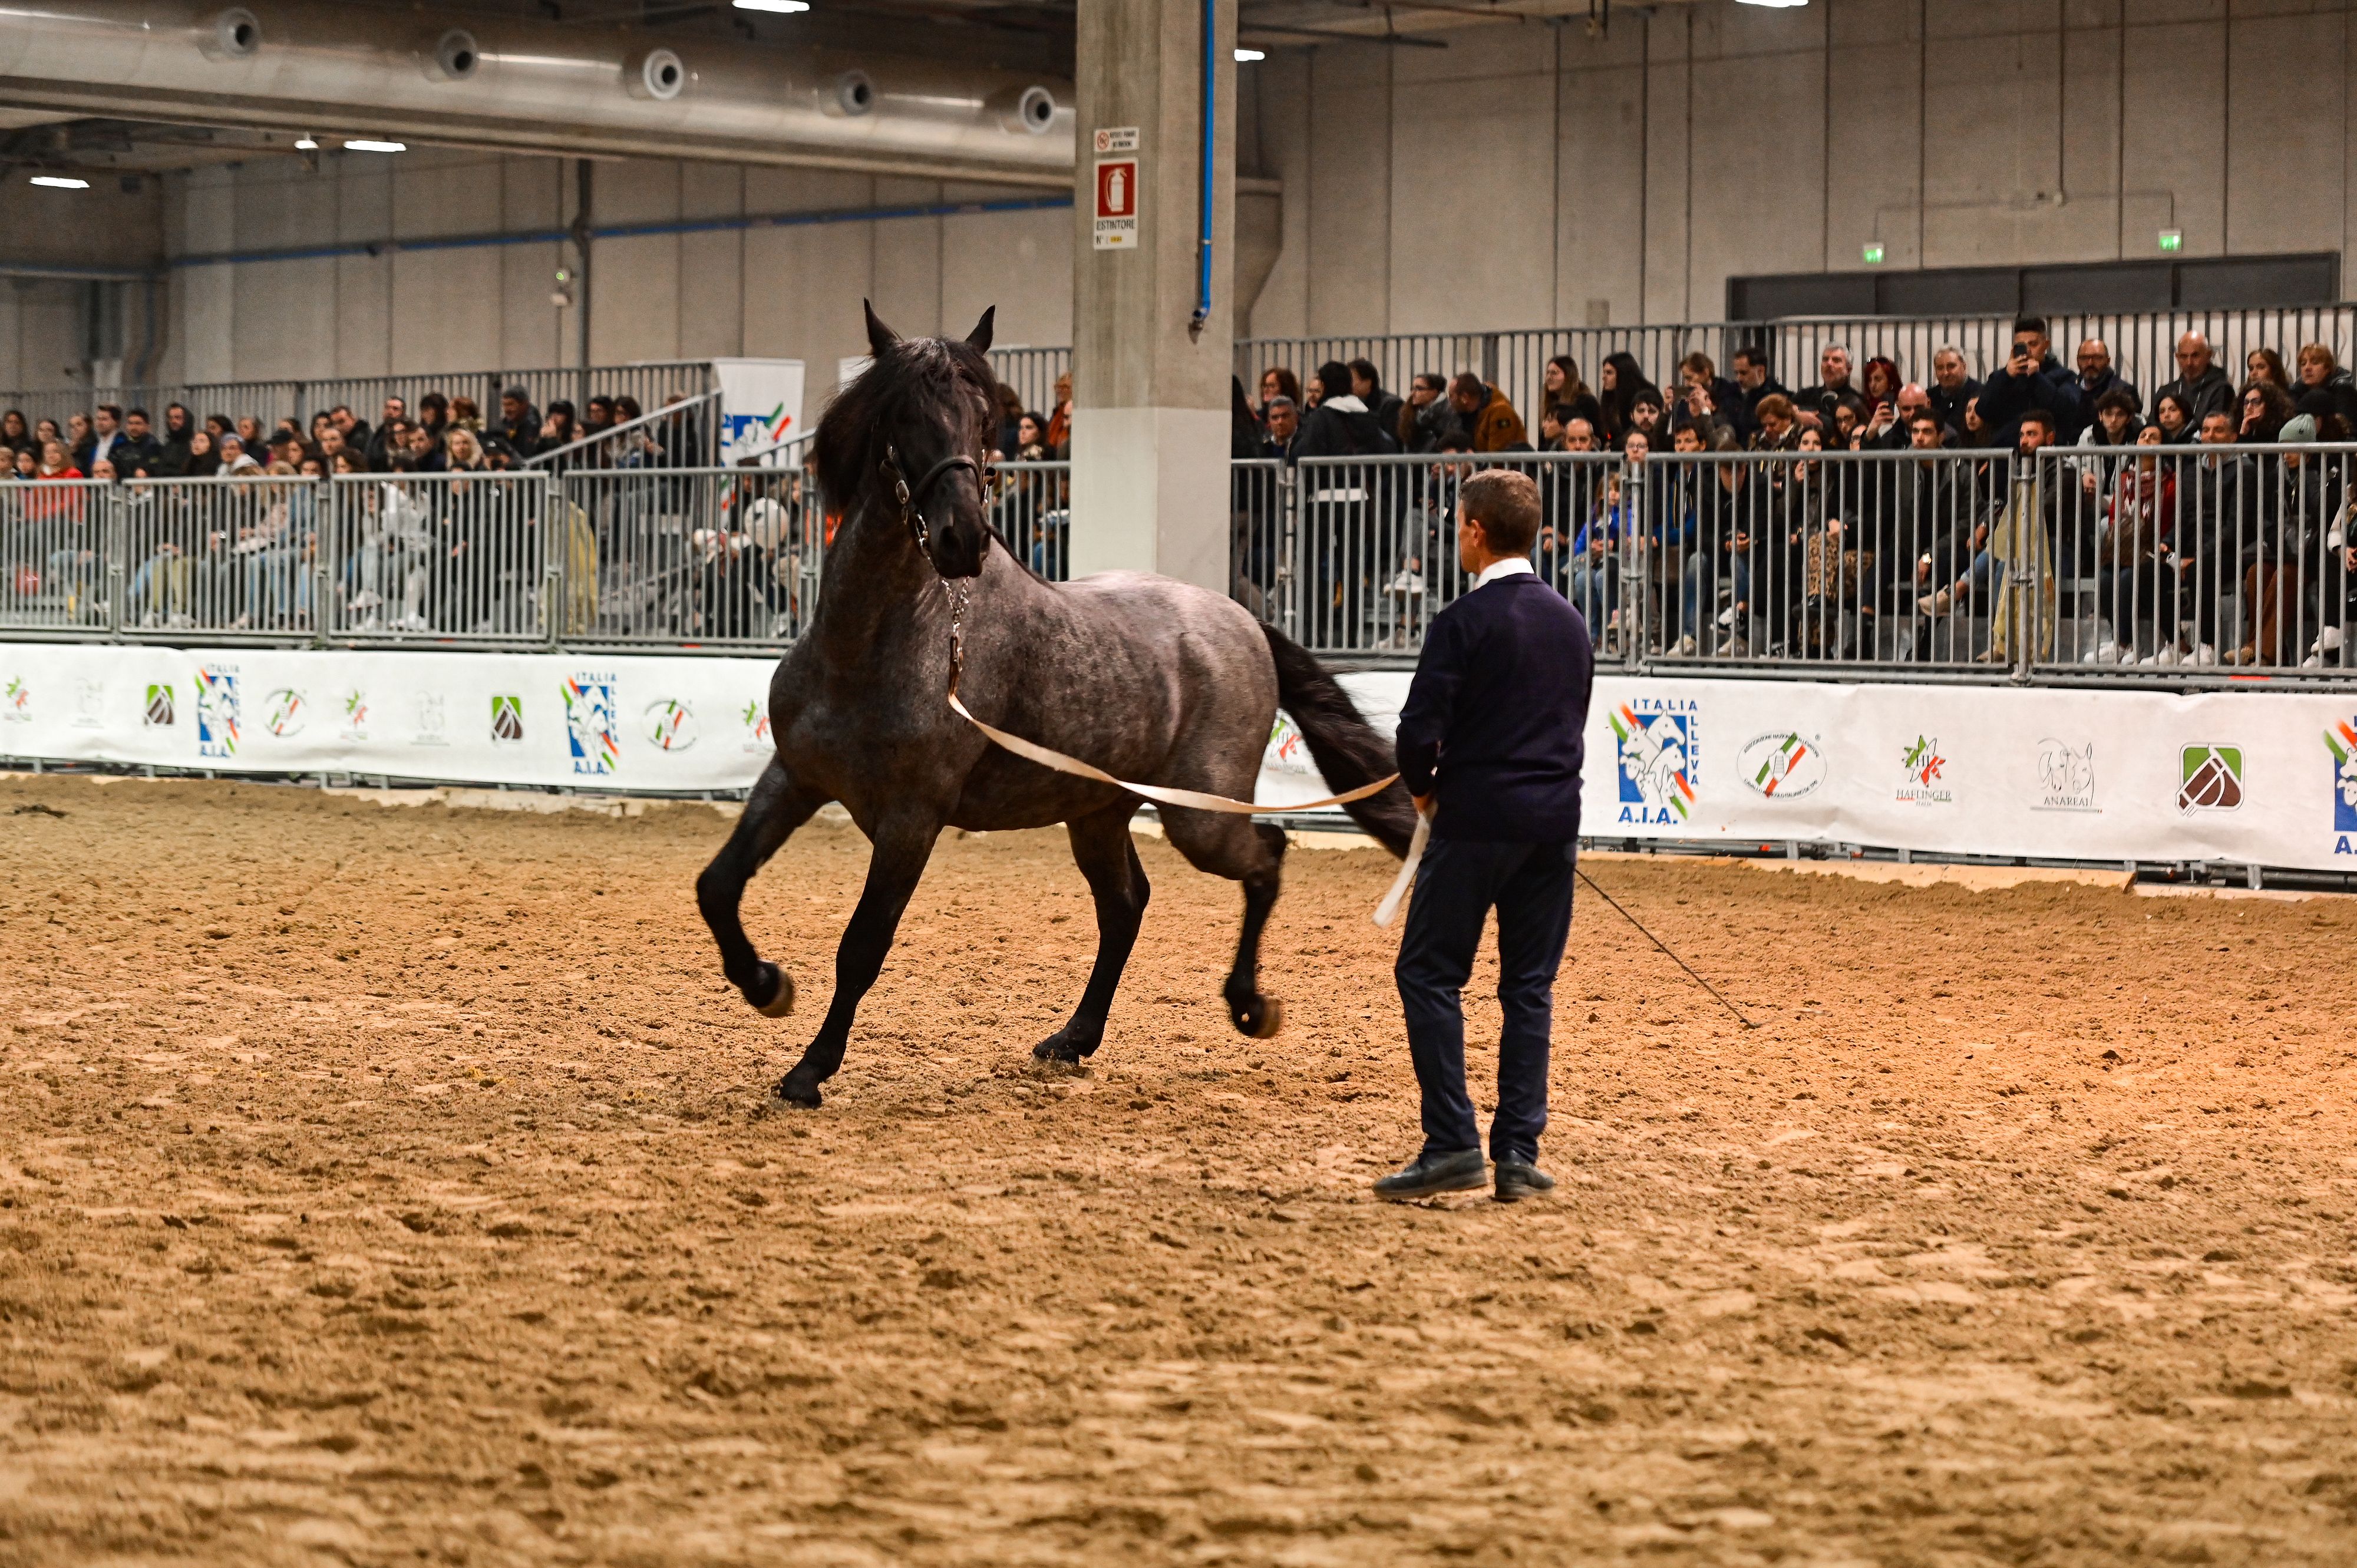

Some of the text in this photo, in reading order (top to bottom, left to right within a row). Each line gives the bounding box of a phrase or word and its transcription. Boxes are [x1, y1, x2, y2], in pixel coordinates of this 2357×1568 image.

[1097, 219, 1136, 231] ESTINTORE
[576, 672, 616, 682] ITALIA
[1633, 698, 1698, 711] ITALIA
[574, 761, 609, 775] A.I.A.
[1896, 790, 1951, 801] HAFLINGER
[1618, 806, 1678, 824] A.I.A.
